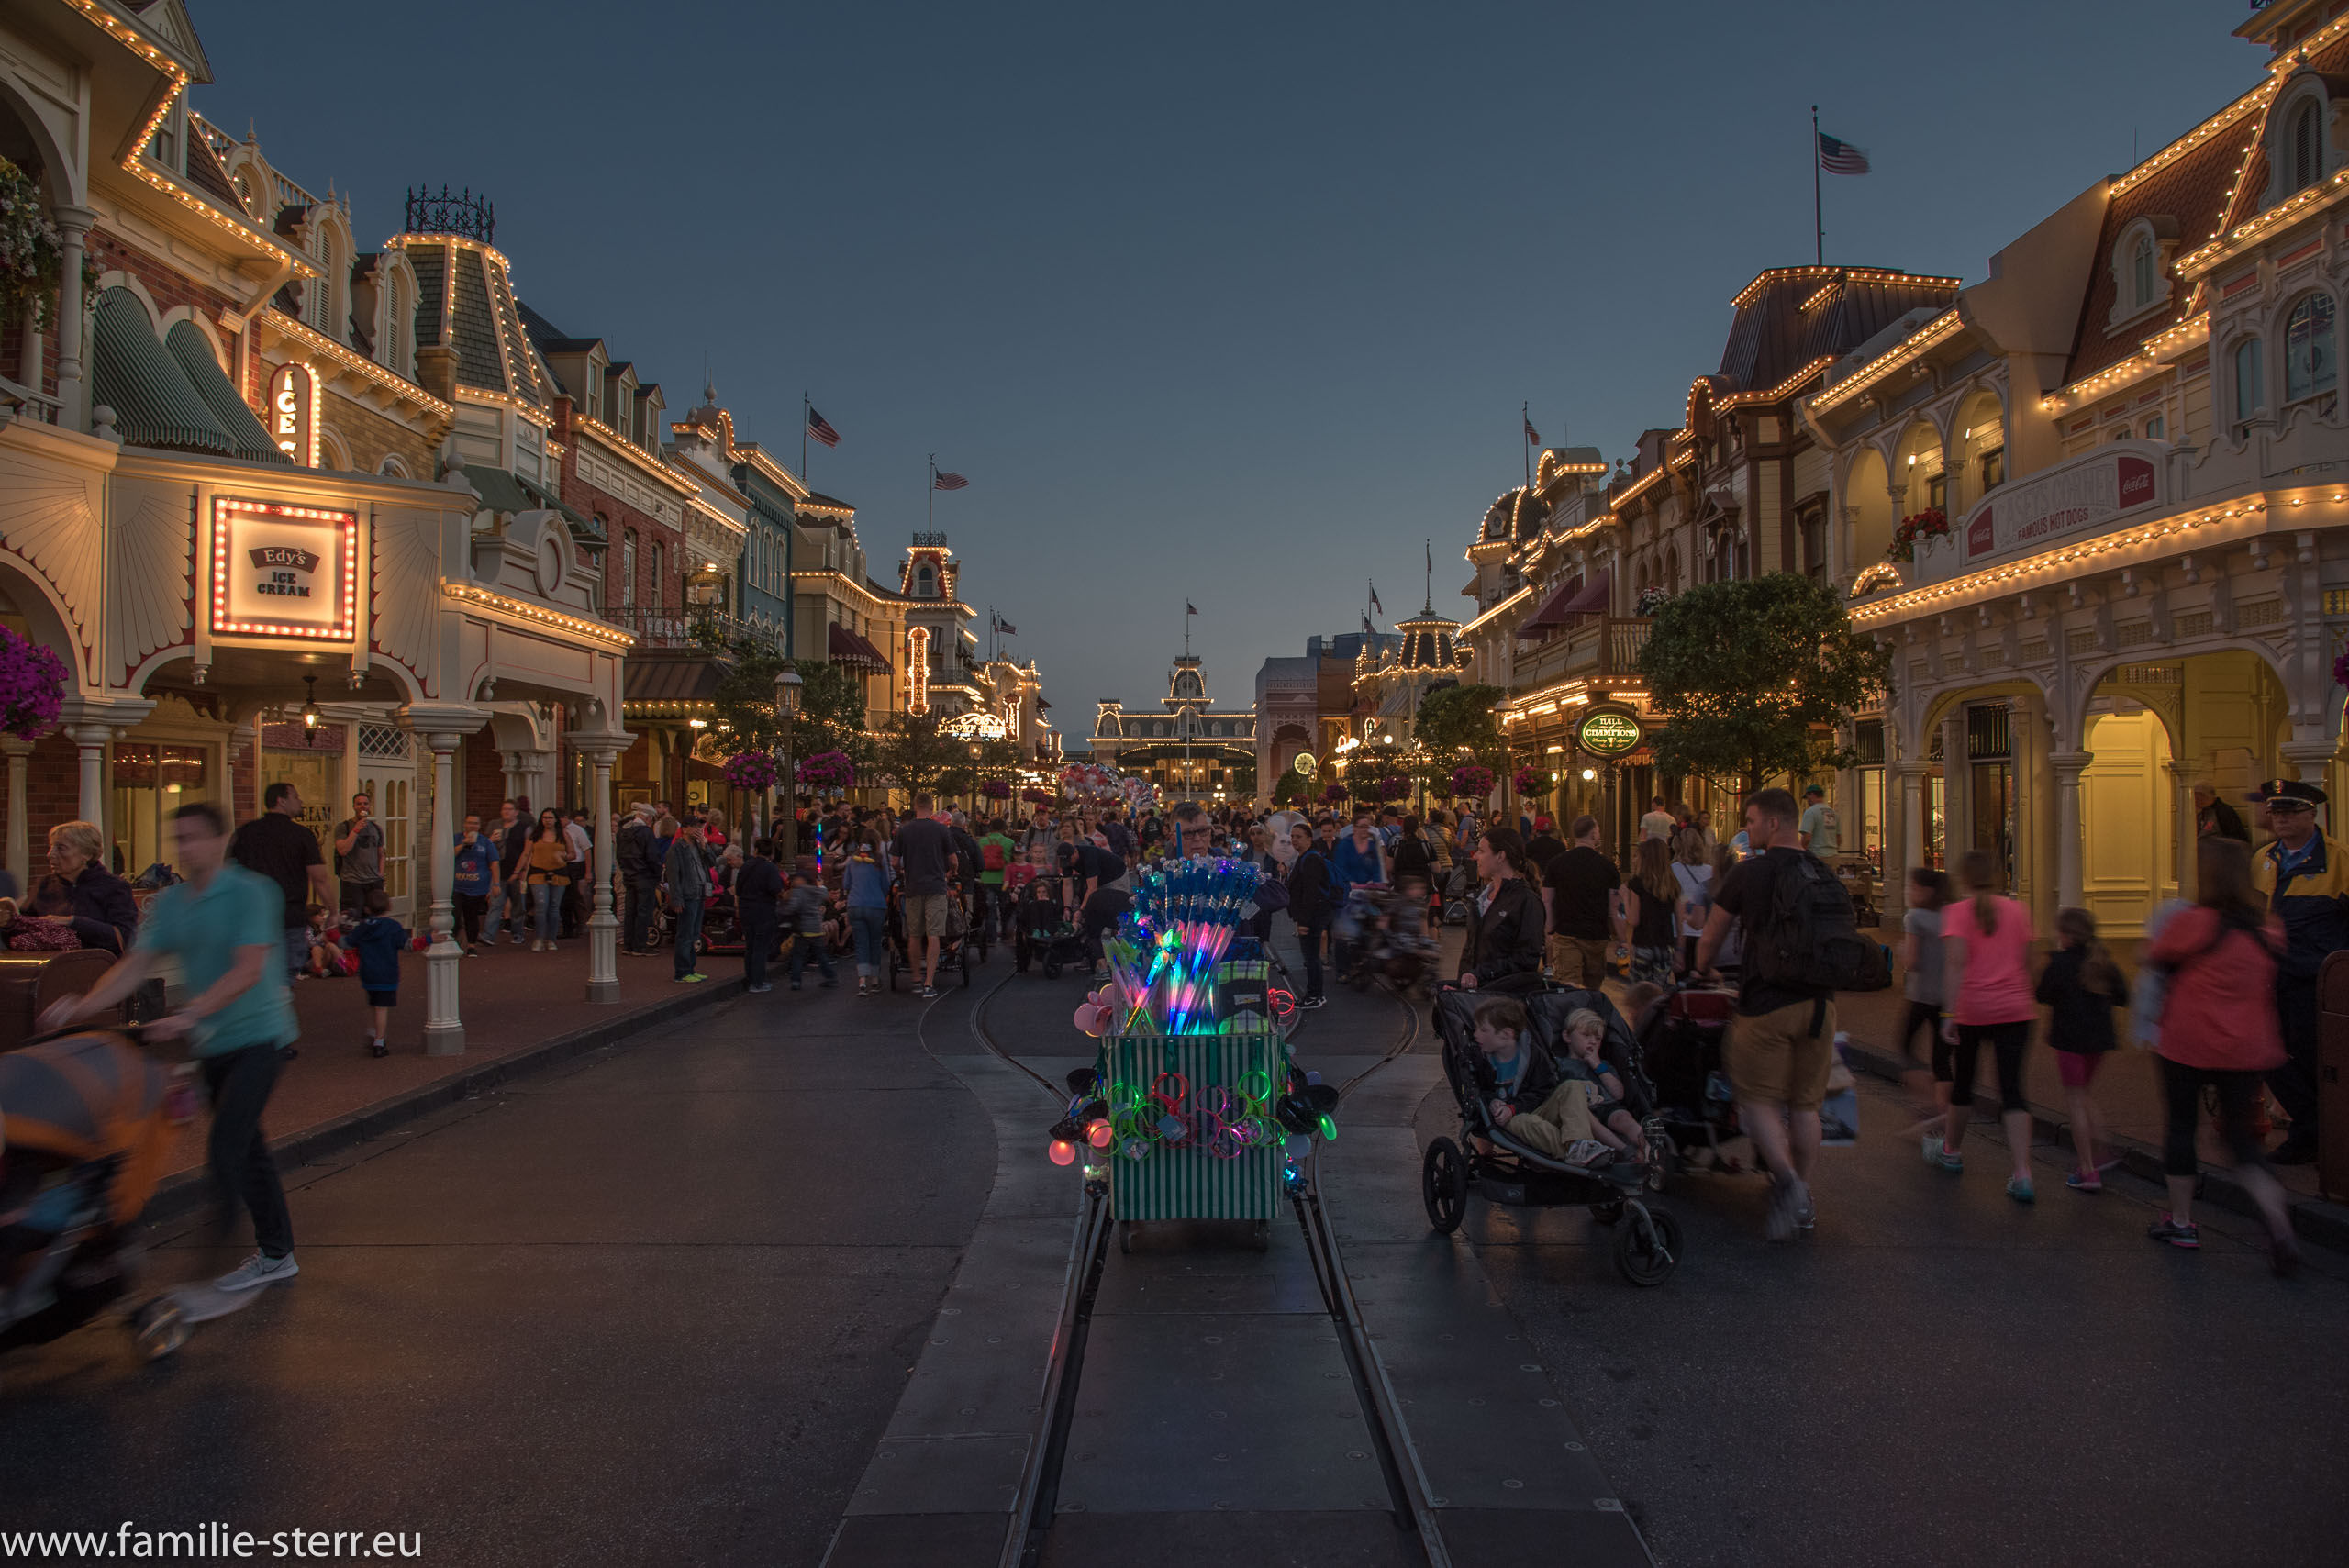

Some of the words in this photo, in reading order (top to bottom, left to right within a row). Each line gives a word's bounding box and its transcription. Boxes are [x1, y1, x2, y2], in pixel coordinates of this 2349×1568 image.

[276, 370, 297, 434] ICE
[2121, 472, 2150, 495] Coca-Cola
[1996, 482, 2049, 539] CASEY'S
[2052, 463, 2116, 509] CORNER
[2017, 516, 2049, 542] FAMOUS
[2050, 510, 2065, 532] HOT
[2066, 506, 2089, 527] DOGS
[1972, 528, 1991, 545] Coca-Cola
[263, 548, 307, 566] Edy's
[272, 571, 296, 584] ICE
[257, 583, 311, 598] CREAM
[915, 640, 923, 677] CRYSTAL
[915, 684, 923, 705] ARTS
